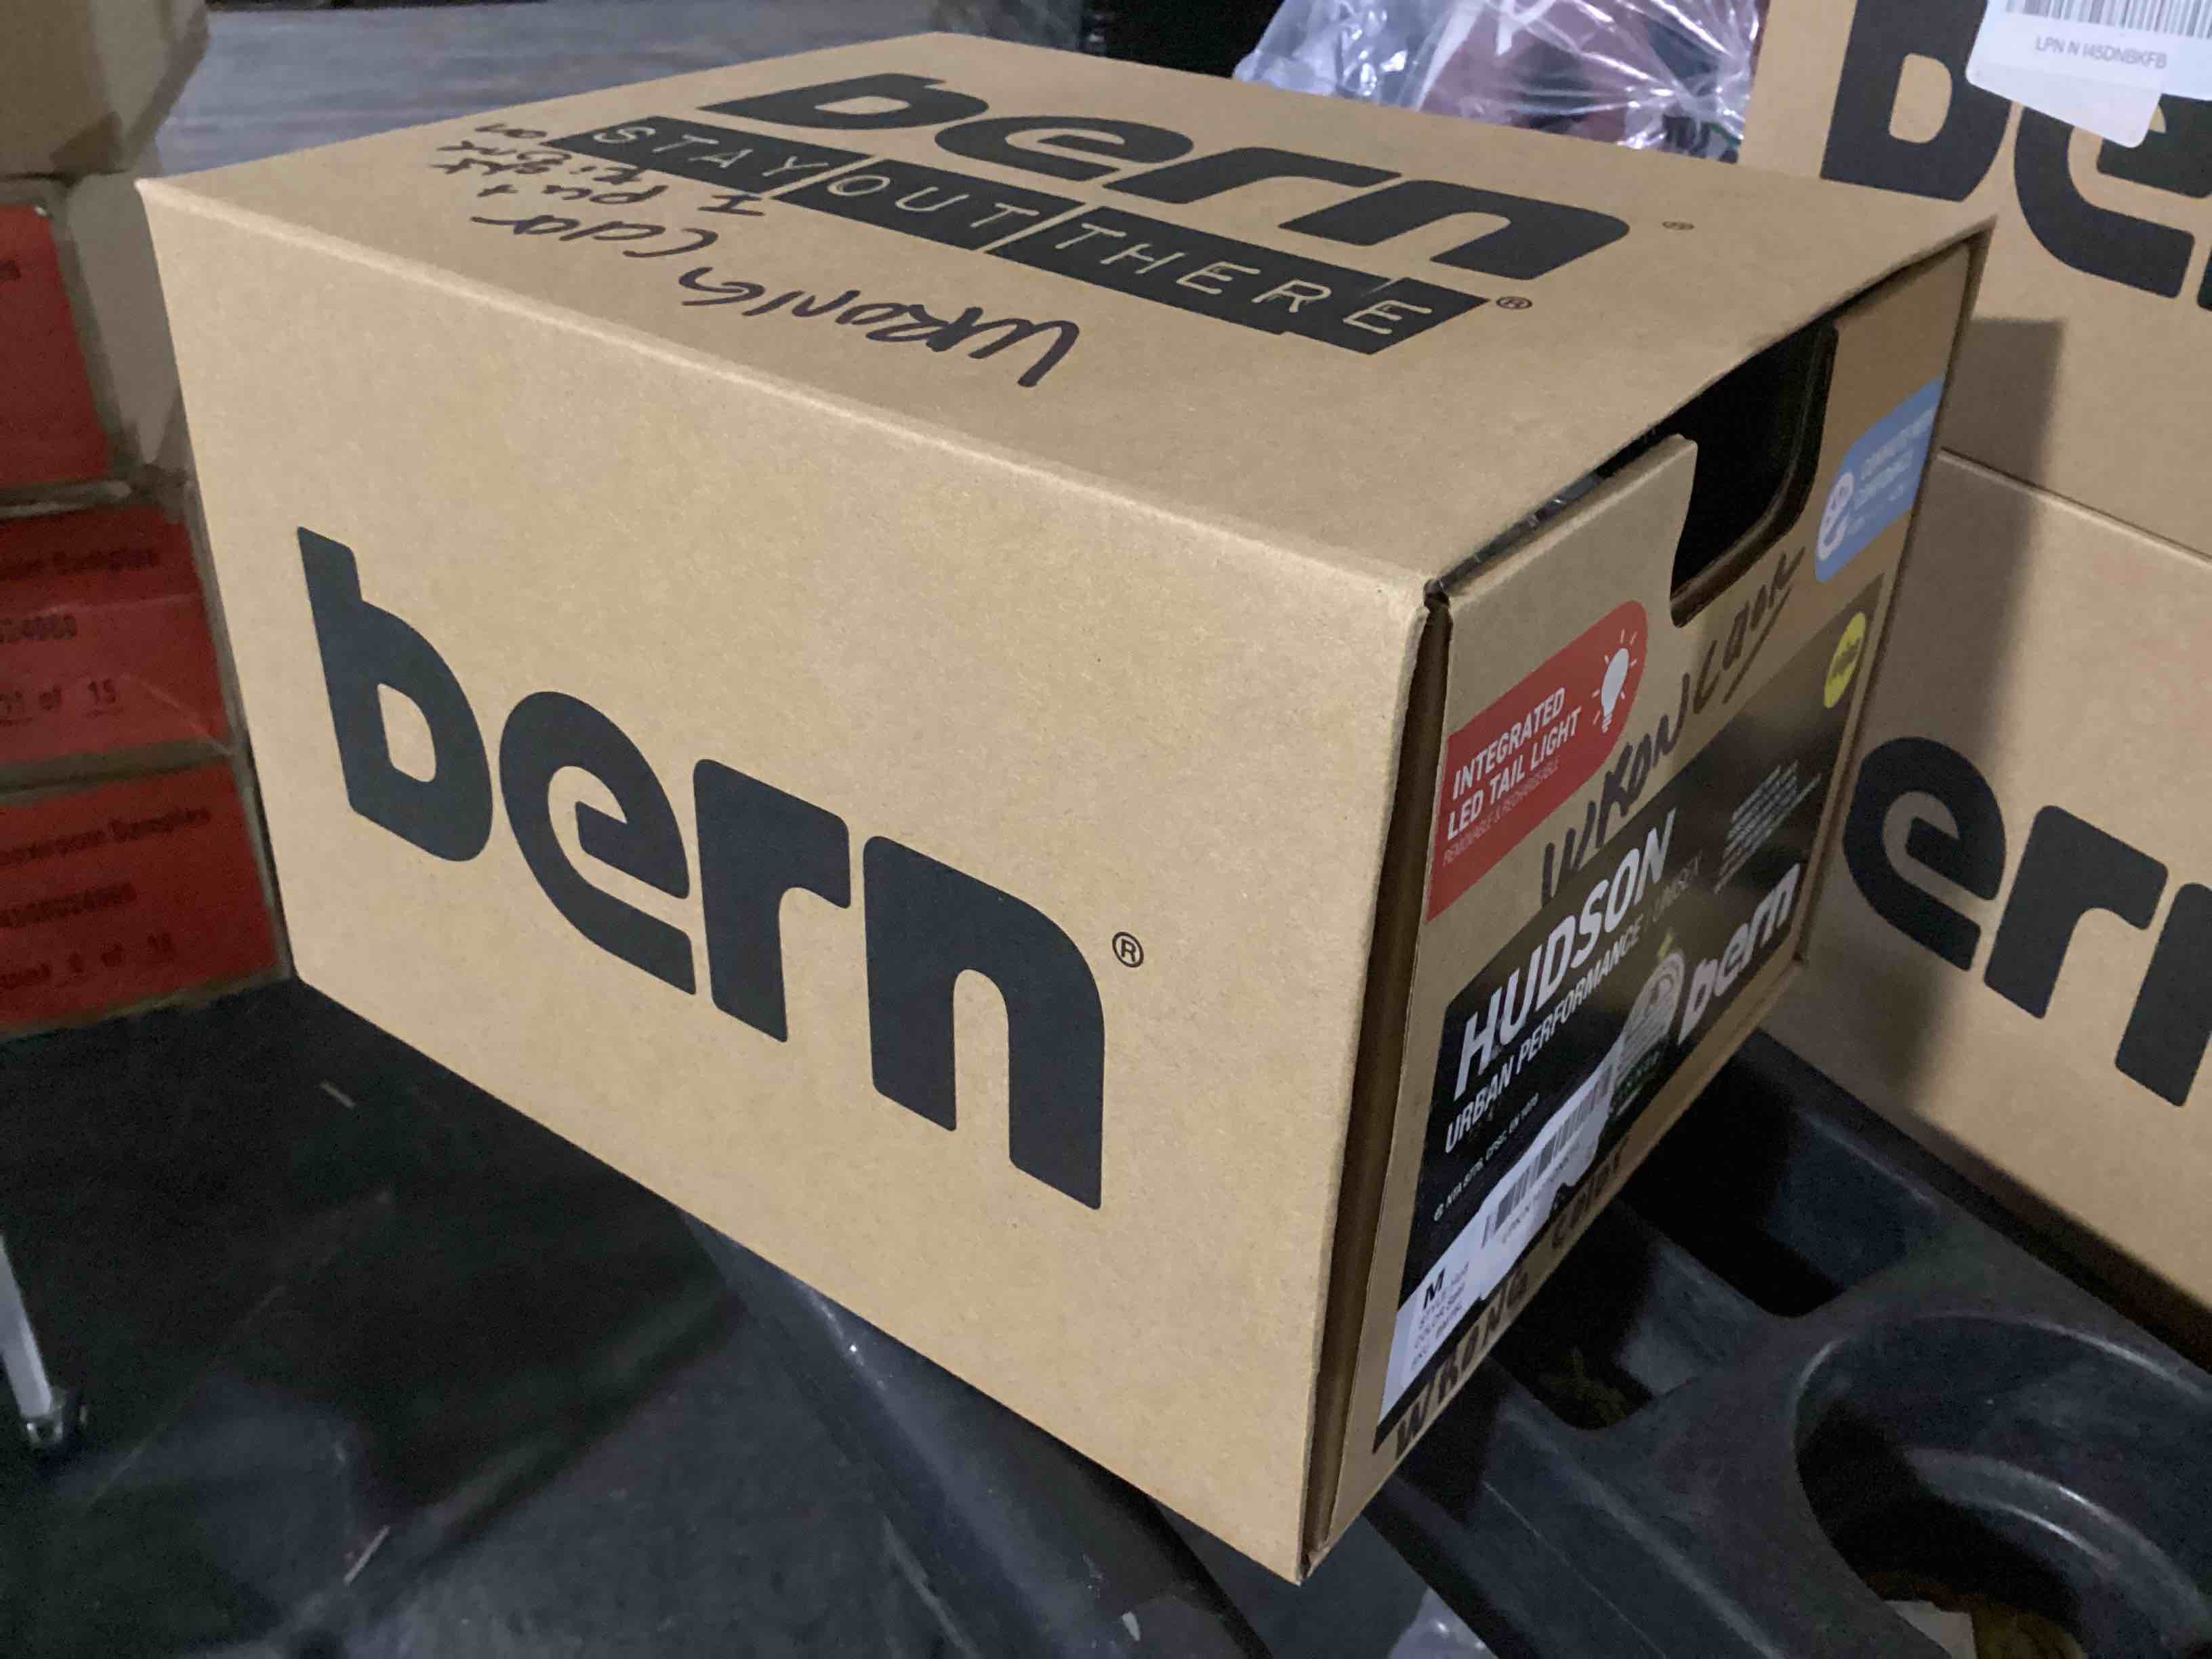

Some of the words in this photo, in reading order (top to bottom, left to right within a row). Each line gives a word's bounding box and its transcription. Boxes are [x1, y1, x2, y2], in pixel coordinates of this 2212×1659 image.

[593, 125, 828, 180] STAY
[826, 174, 1041, 229] OUT
[1054, 222, 1433, 334] THERE
[696, 73, 1631, 281] bern
[1447, 789, 1484, 841] LED
[1490, 754, 1525, 804] TAIL
[1530, 705, 1582, 771] LIGHT
[1452, 687, 1565, 800] INTEGRATED
[296, 525, 1106, 1211] bern
[1453, 807, 1676, 1103] HUDSON
[1677, 862, 1801, 1046] bern
[1444, 1053, 1515, 1153] URBAN
[1515, 916, 1643, 1076] PERFORMANCE
[1422, 1269, 1446, 1309] M
